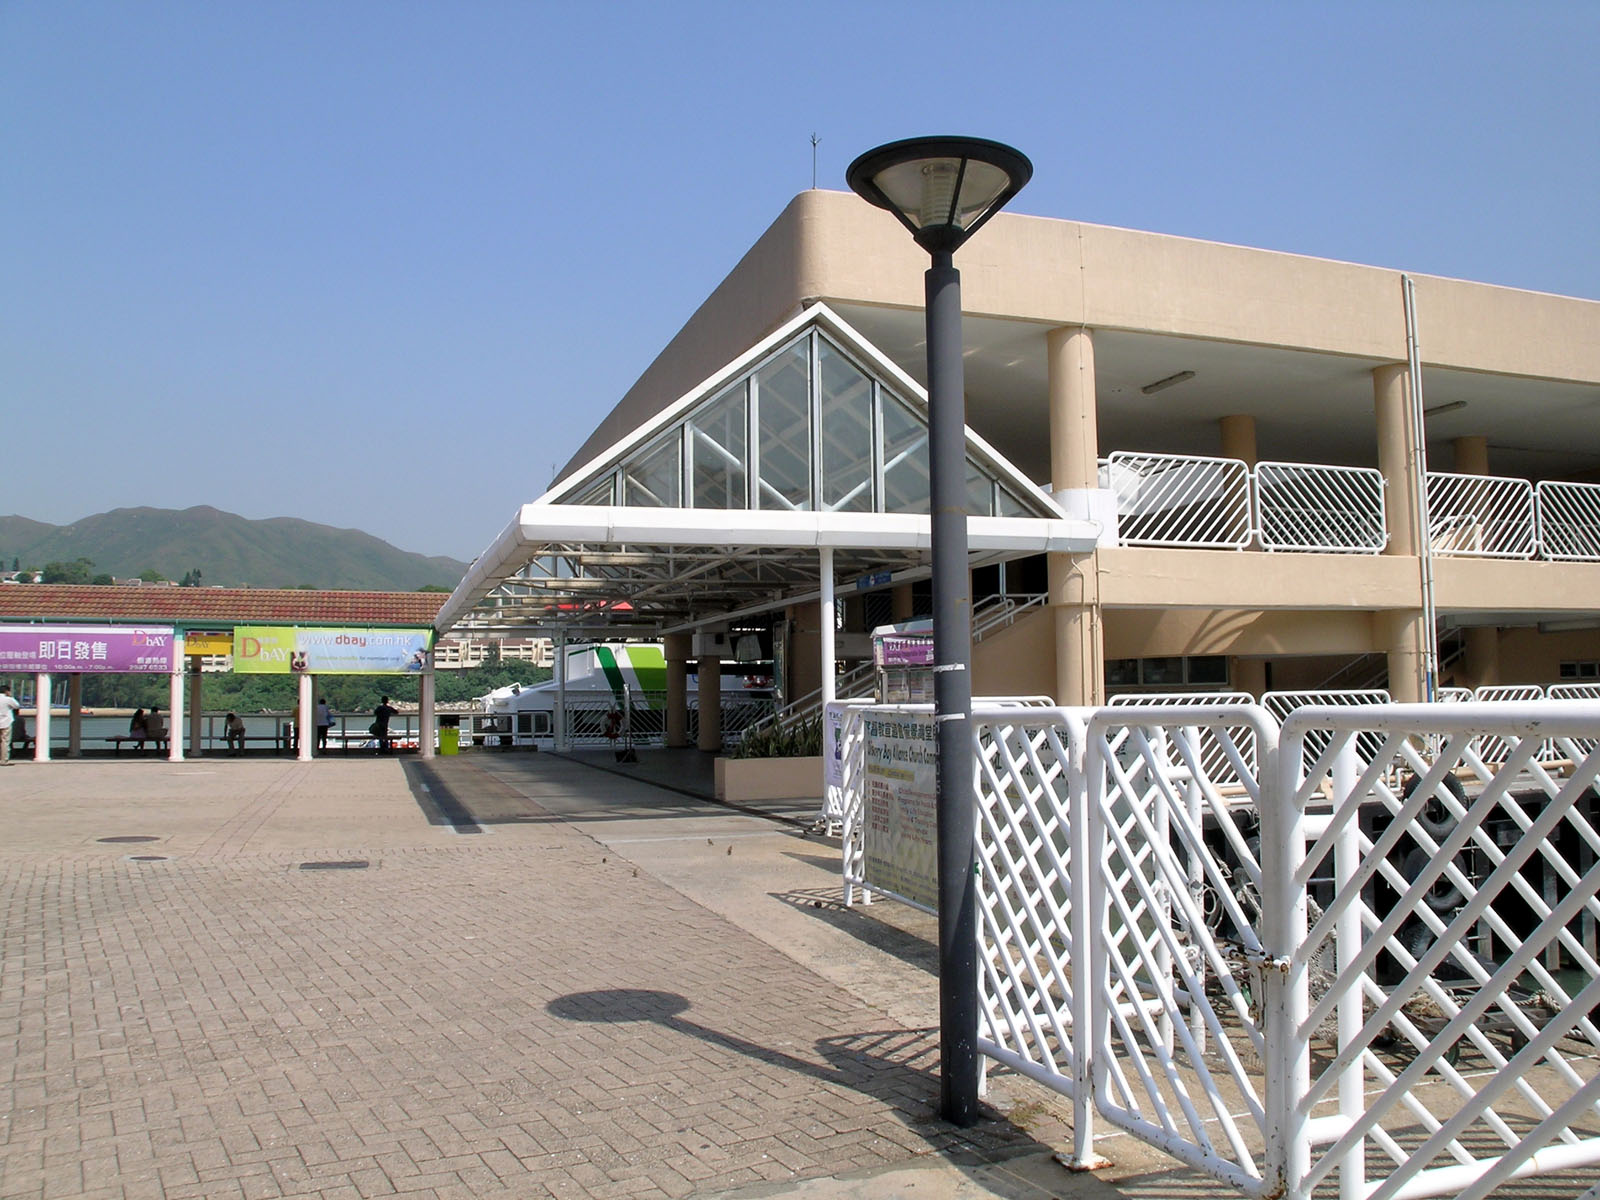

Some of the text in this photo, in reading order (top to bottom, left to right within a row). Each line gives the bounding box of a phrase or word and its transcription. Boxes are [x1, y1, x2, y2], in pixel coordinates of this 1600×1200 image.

[39, 641, 108, 660] 即日發售
[240, 637, 289, 661] DbAY
